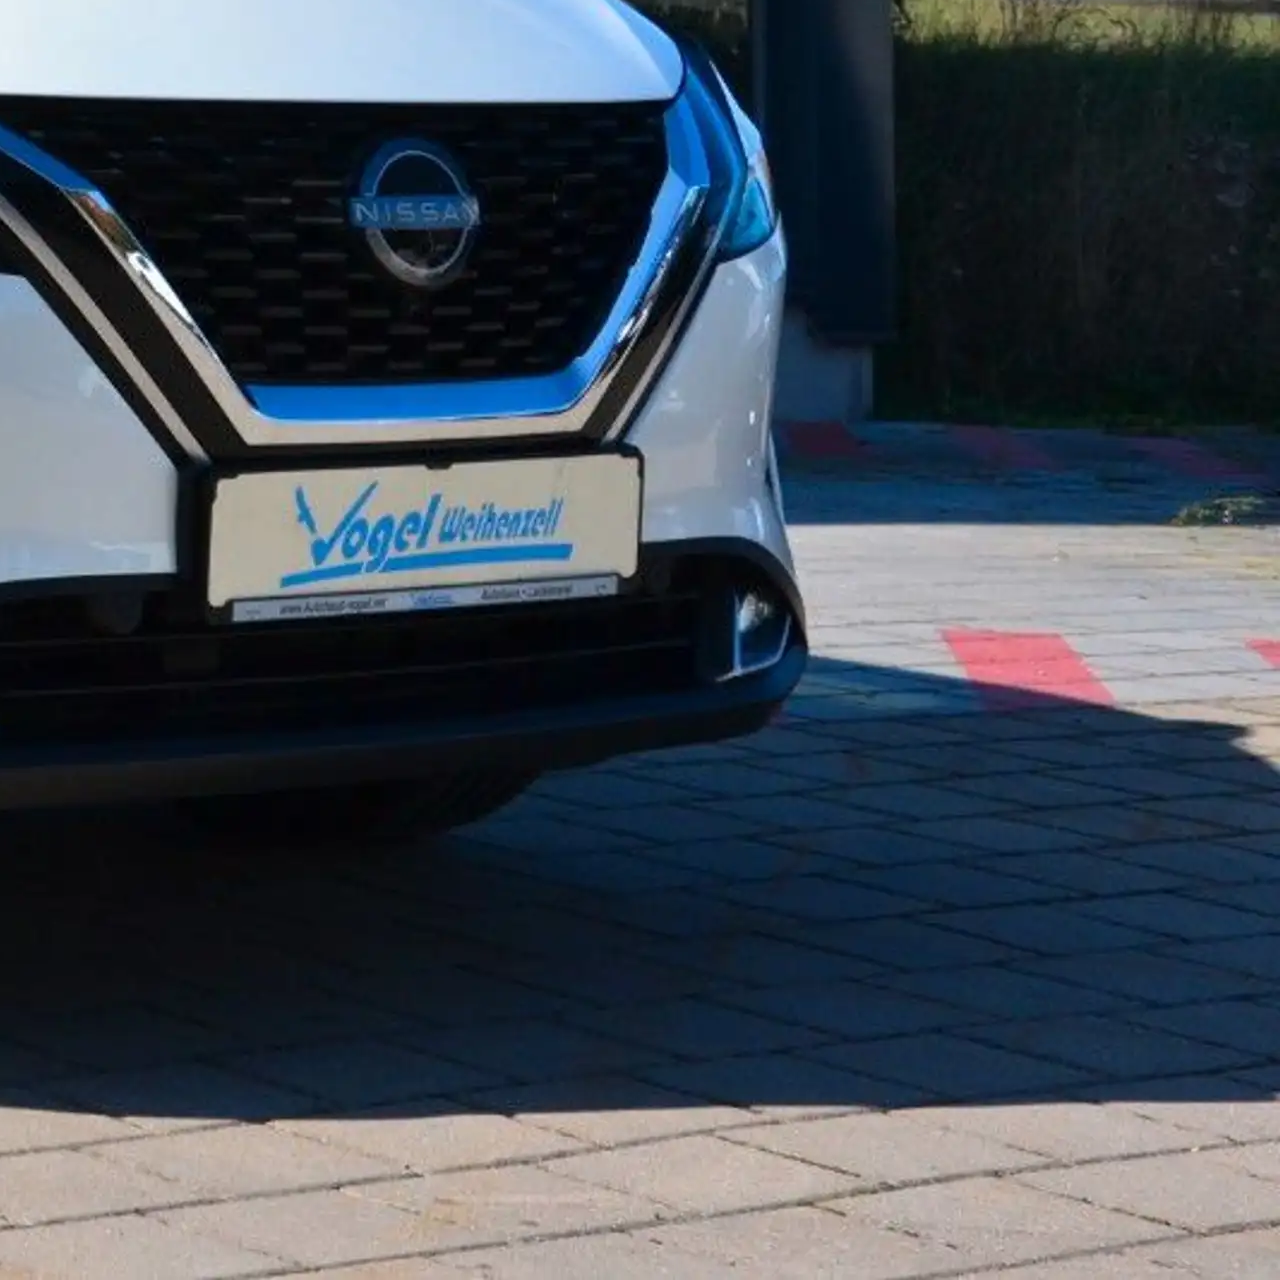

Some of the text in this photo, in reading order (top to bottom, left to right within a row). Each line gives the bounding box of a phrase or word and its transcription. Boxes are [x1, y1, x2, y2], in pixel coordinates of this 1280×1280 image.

[353, 200, 481, 225] NISSAN
[295, 480, 564, 572] Vogel Weihenzell
